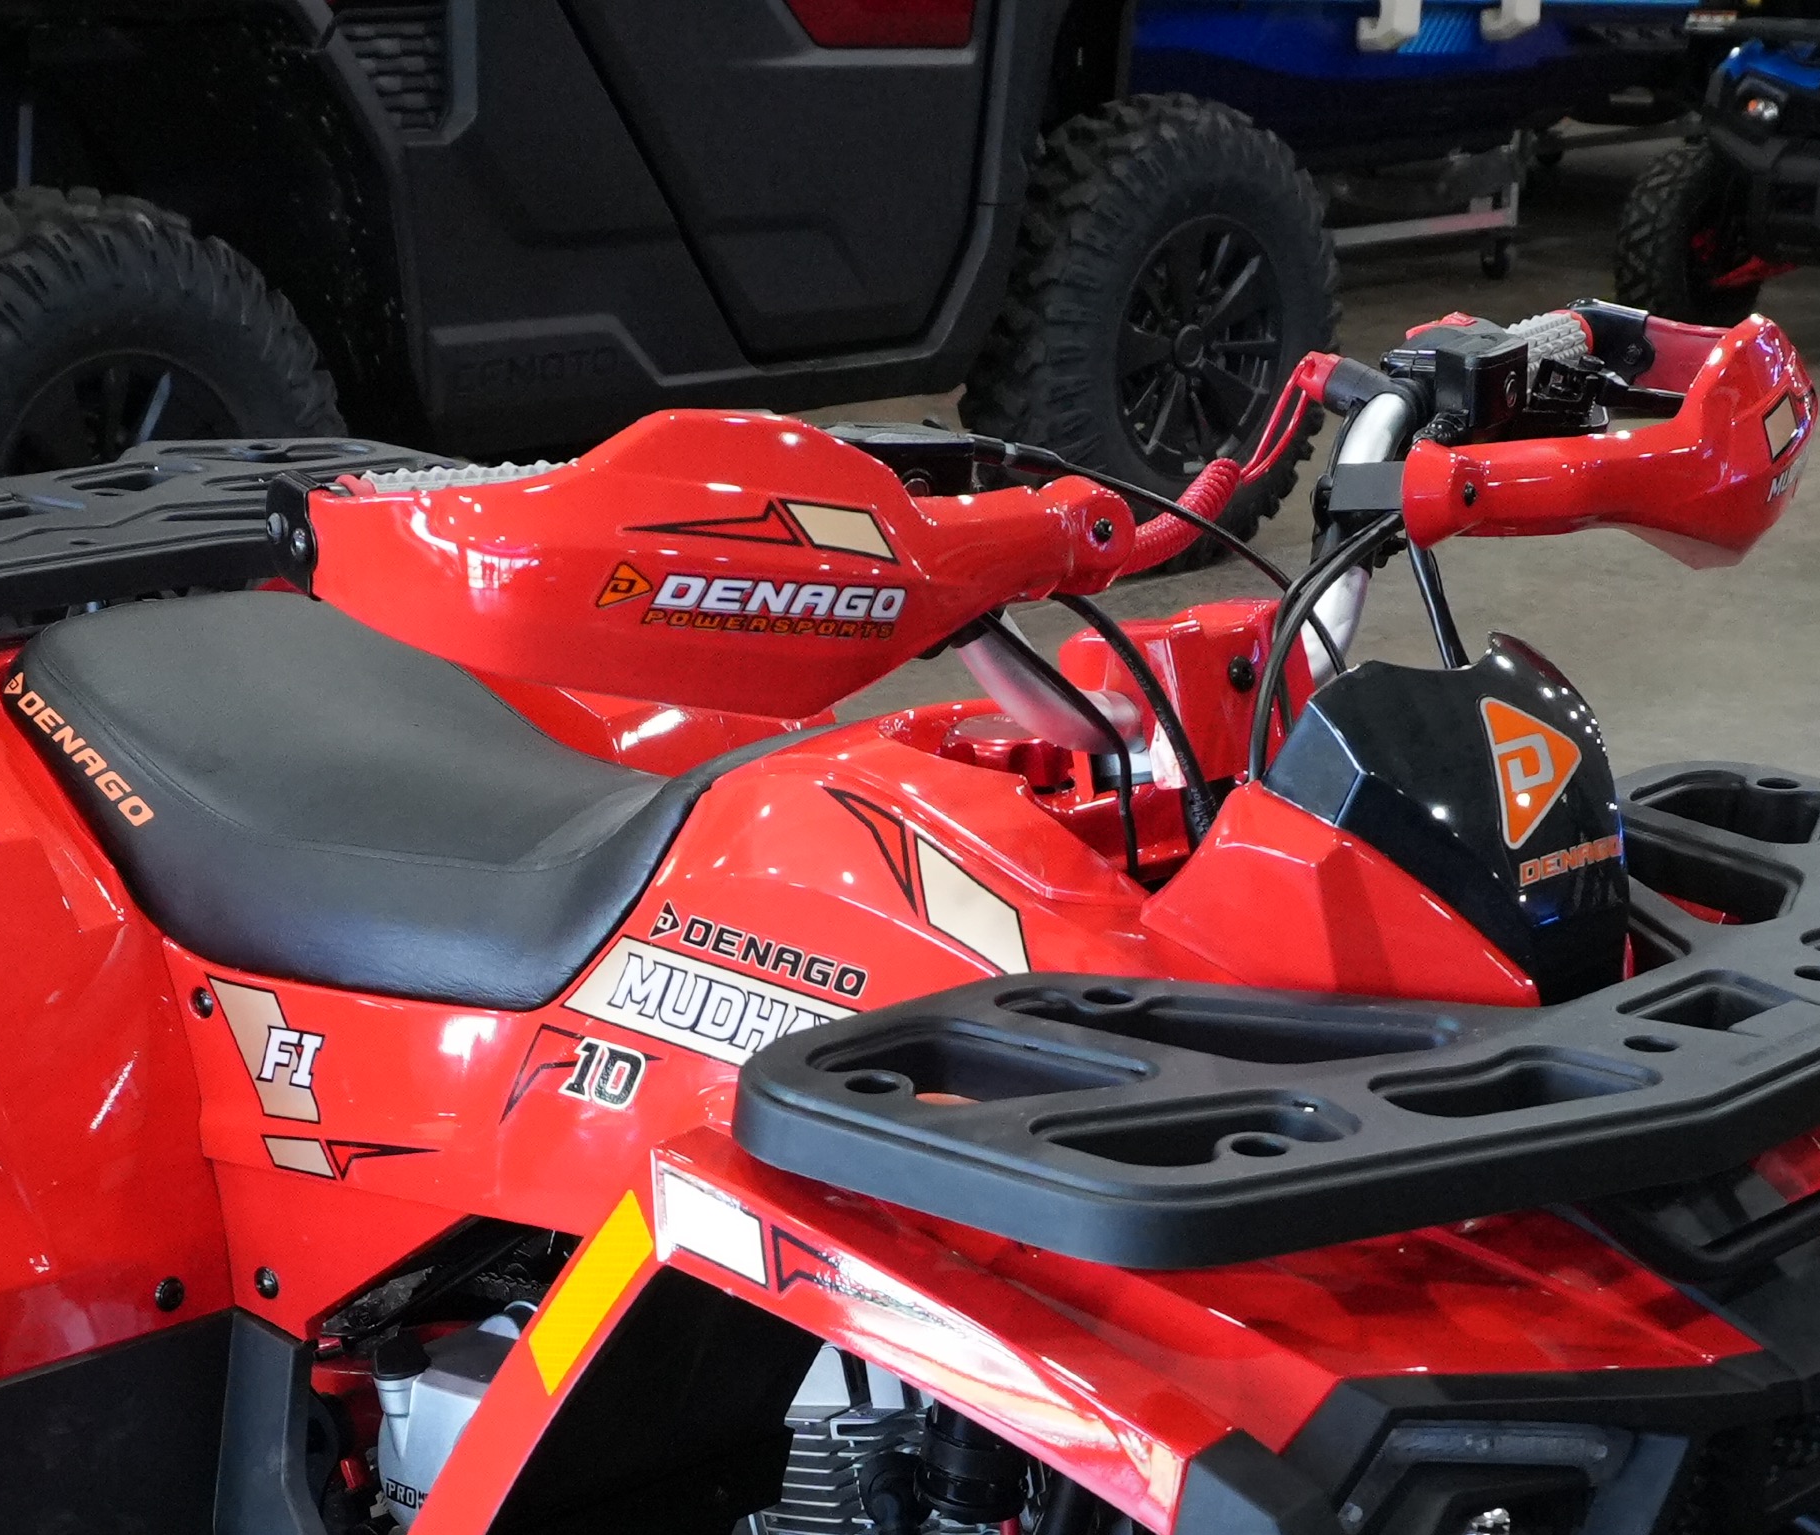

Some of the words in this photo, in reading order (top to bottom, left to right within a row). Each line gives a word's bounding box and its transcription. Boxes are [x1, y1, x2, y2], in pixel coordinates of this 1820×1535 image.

[641, 608, 896, 639] POWERSPORTS
[651, 573, 907, 620] DENAGO
[17, 690, 155, 827] DENAGO
[680, 914, 869, 999] DENAGO
[607, 951, 831, 1053] MUDH
[256, 1025, 325, 1089] FI
[559, 1037, 645, 1110] 10
[387, 1480, 416, 1507] PRO
